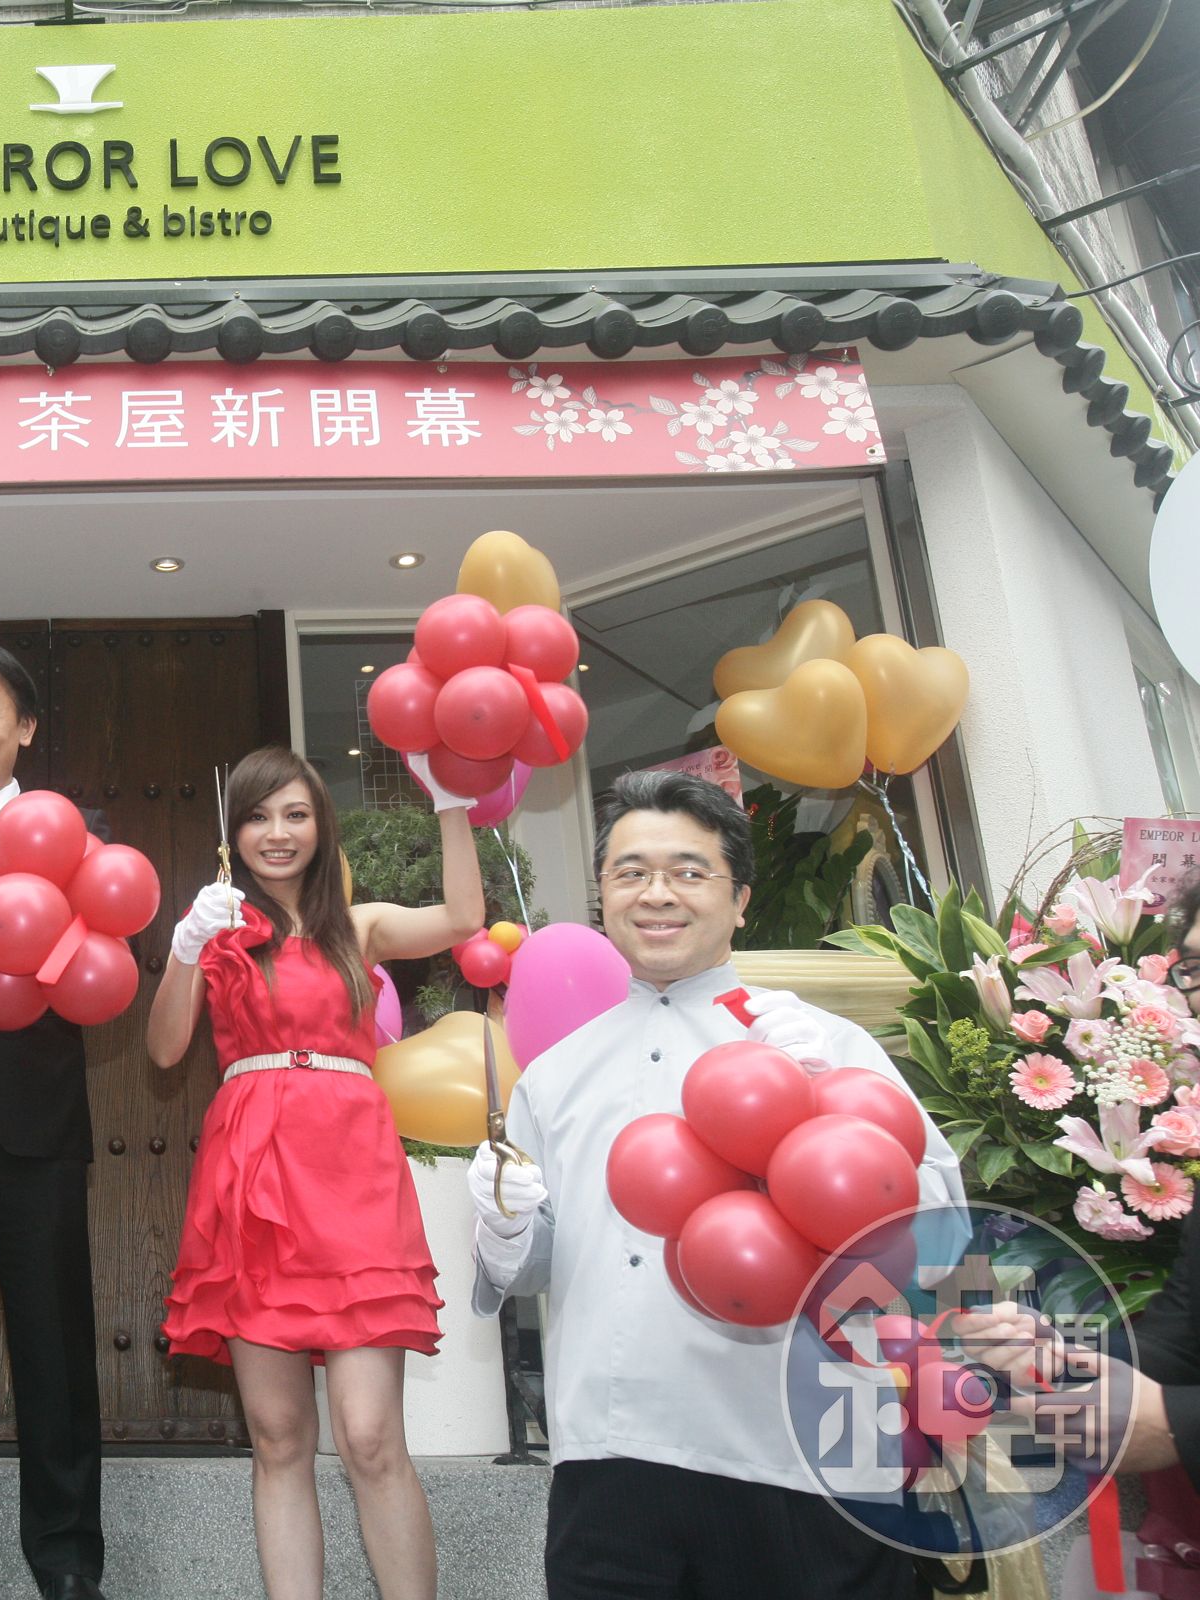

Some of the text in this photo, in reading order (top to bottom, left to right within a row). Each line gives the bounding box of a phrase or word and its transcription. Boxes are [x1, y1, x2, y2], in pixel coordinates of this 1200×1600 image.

[170, 134, 342, 188] LOVE
[123, 205, 151, 238] &
[163, 204, 272, 237] bistro
[1140, 829, 1184, 842] EMPEOR
